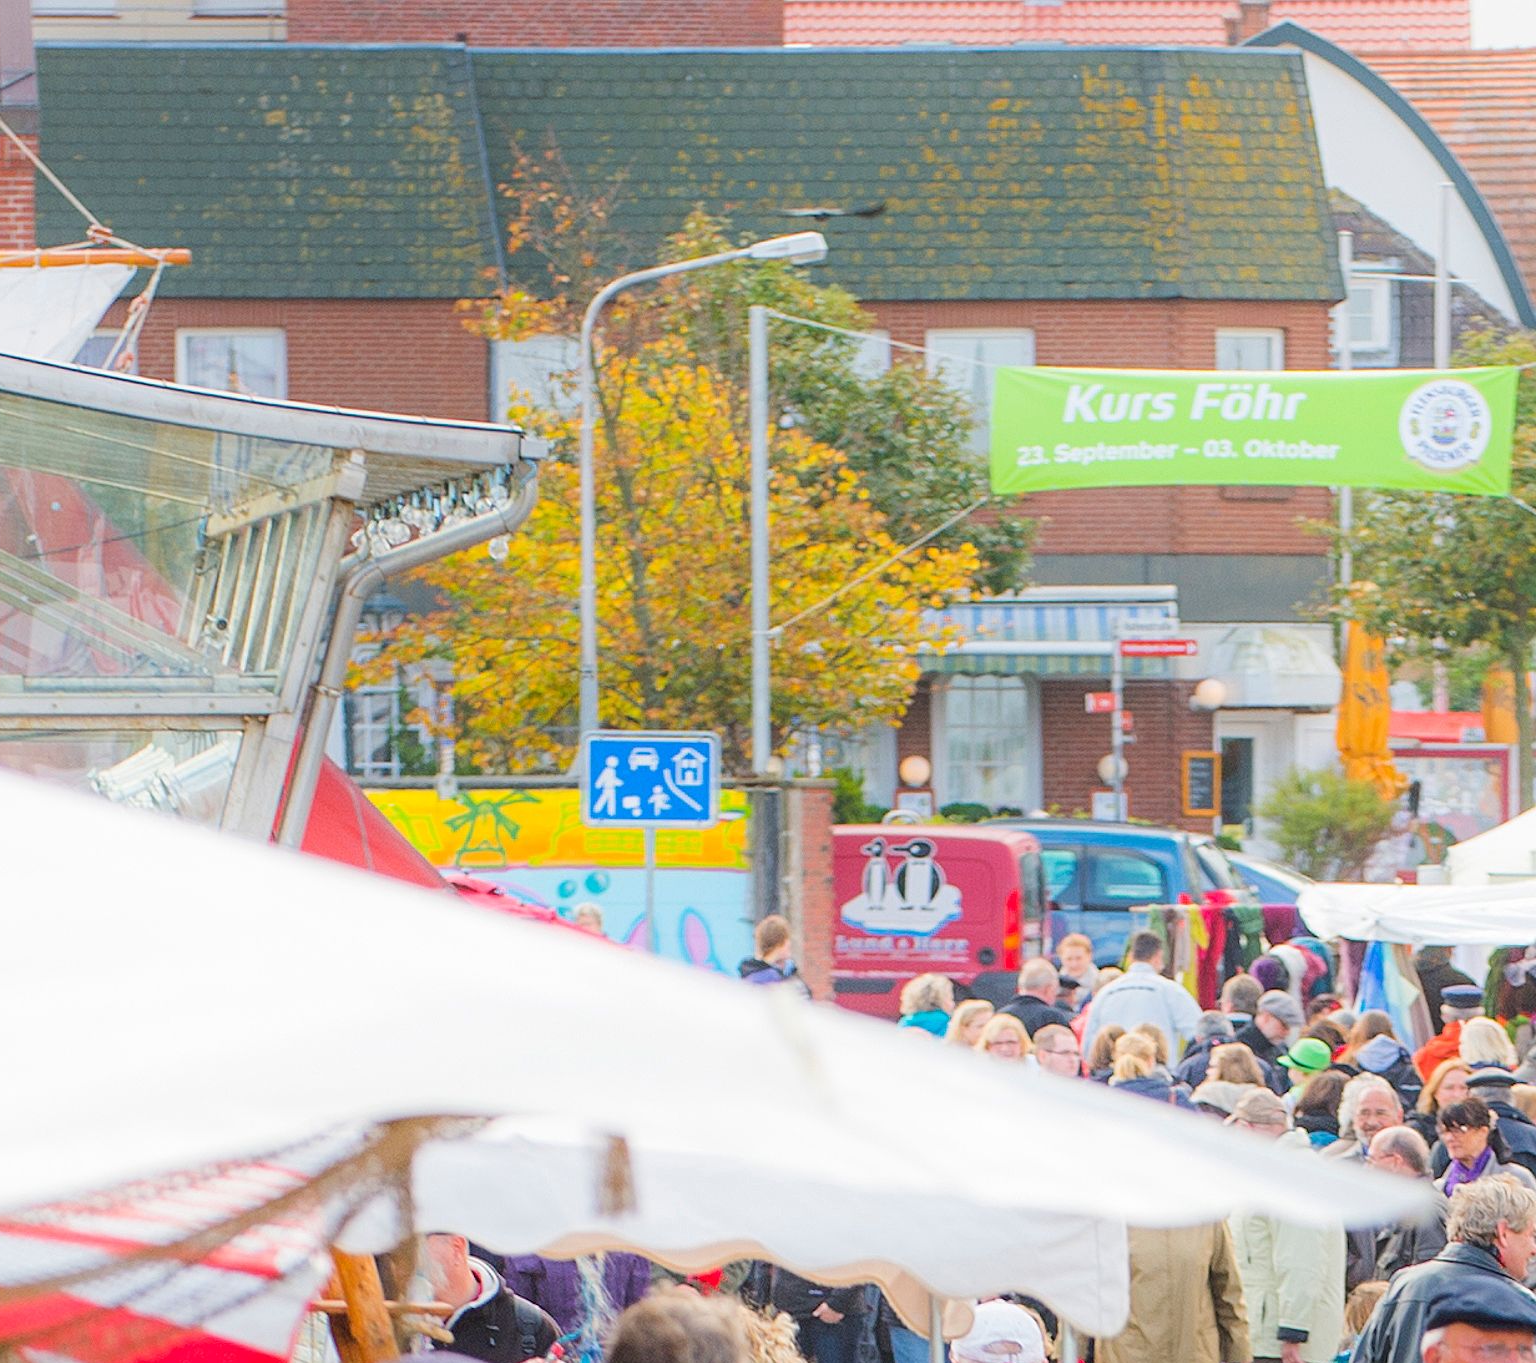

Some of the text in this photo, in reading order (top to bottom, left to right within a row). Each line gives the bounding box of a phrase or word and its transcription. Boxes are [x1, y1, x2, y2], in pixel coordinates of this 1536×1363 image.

[1062, 383, 1307, 423] Kurs Föhr
[1016, 445, 1049, 466] 23.
[1054, 440, 1179, 465] September
[1203, 439, 1238, 459] 03.
[1244, 439, 1340, 460] Oktober
